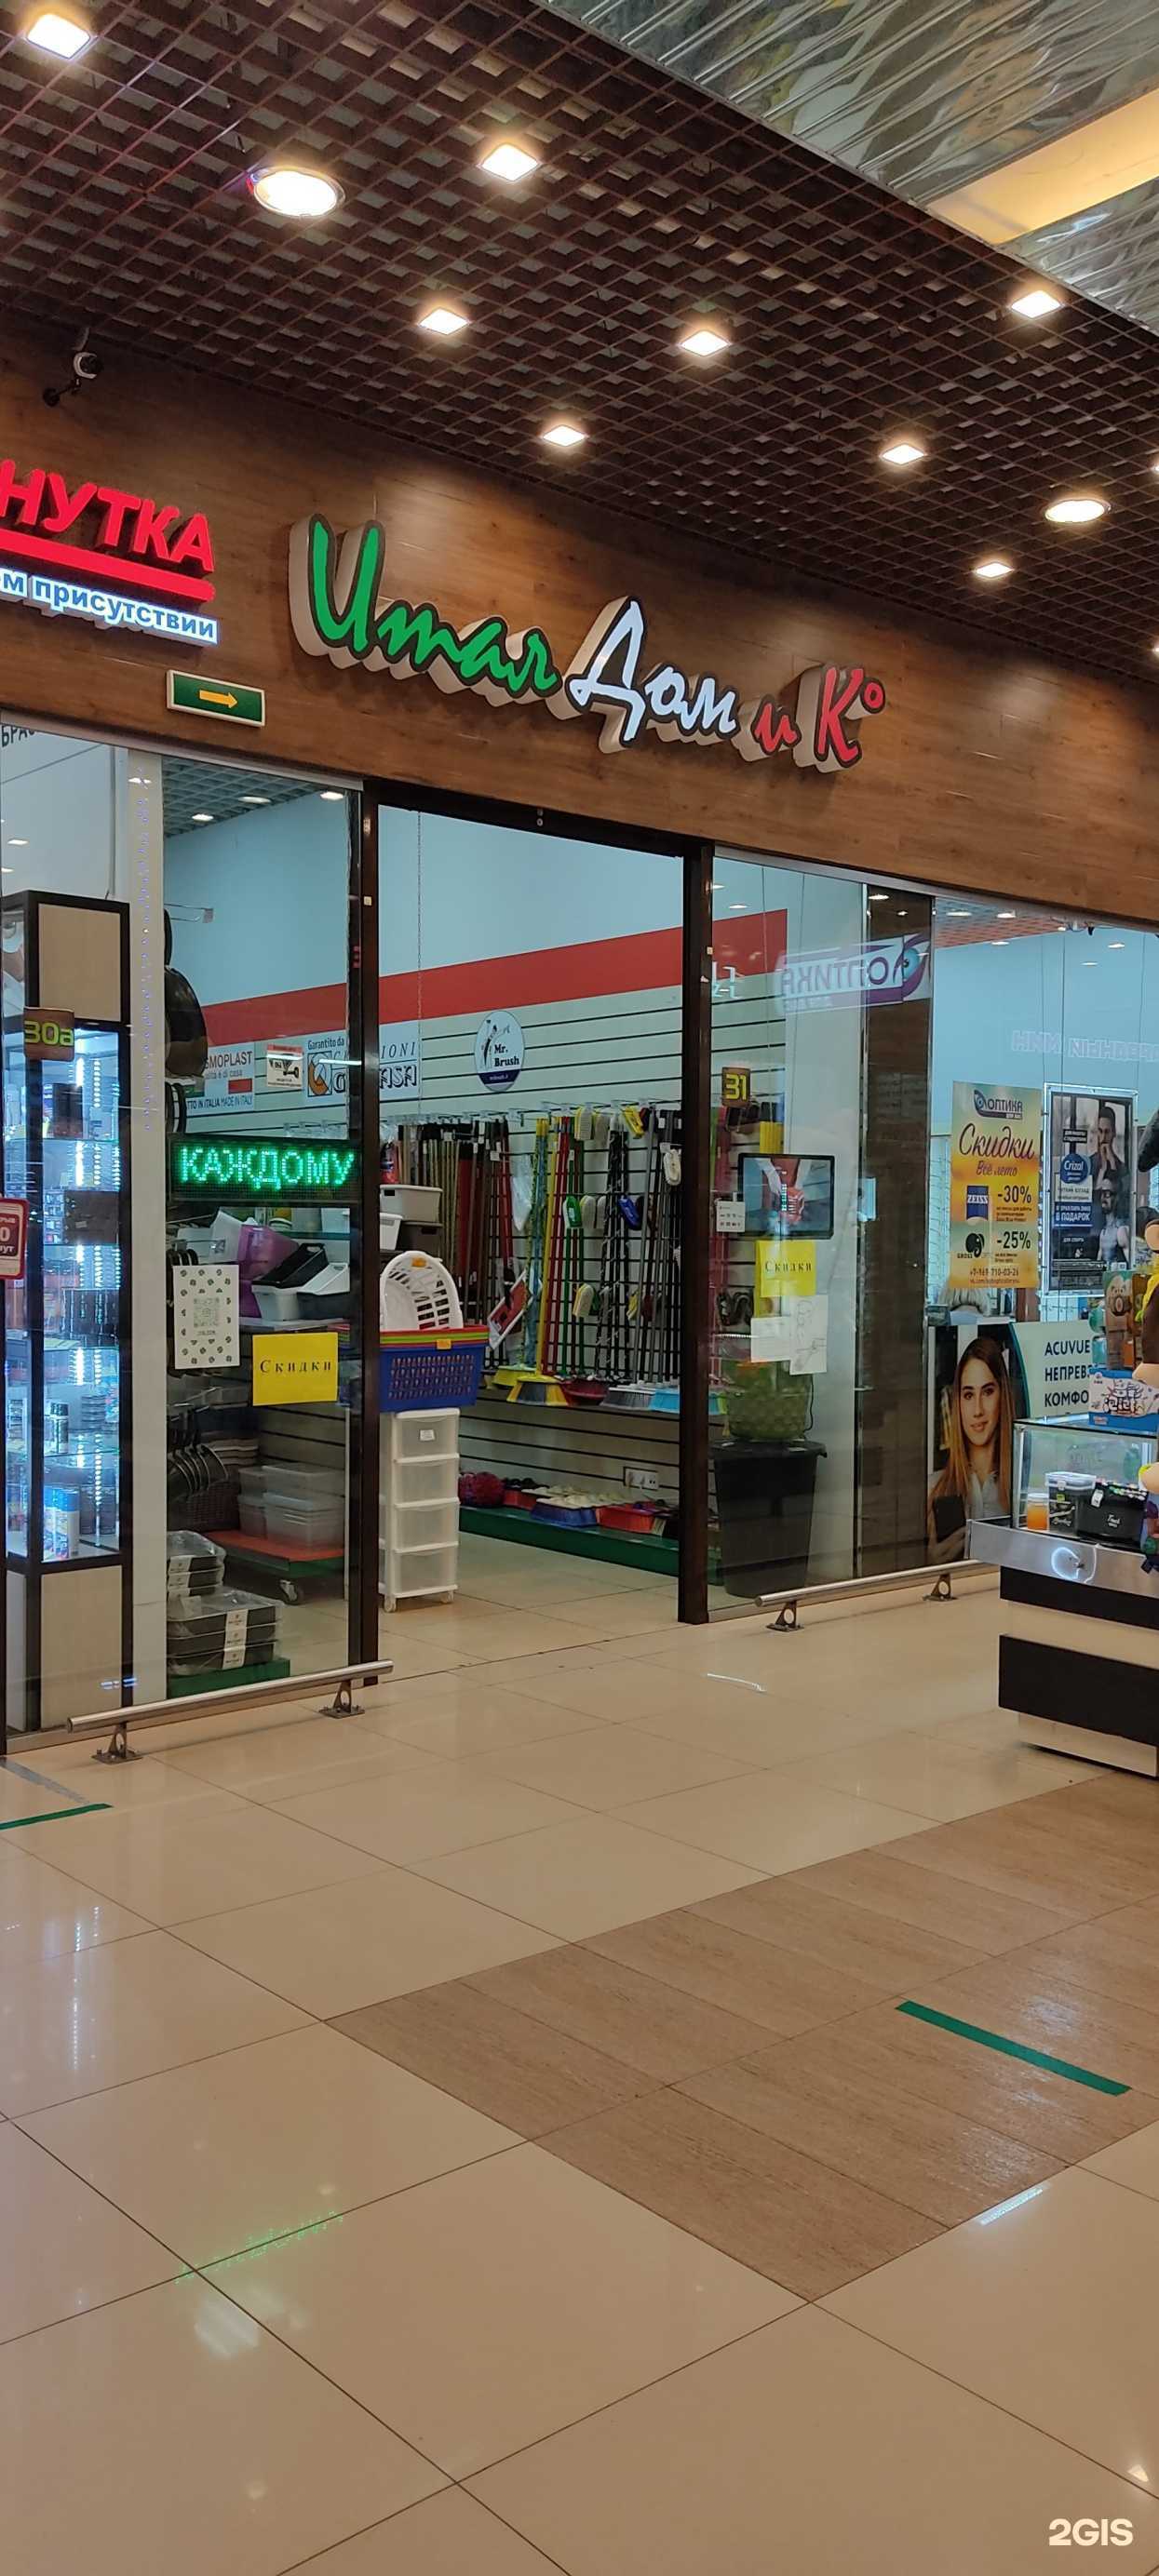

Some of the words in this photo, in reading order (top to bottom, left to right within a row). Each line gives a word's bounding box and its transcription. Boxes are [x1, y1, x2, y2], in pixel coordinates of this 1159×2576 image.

[34, 578, 215, 638] присутствии
[494, 1043, 508, 1054] Mr.
[494, 1055, 519, 1067] Brush
[725, 1074, 747, 1100] 31
[987, 1098, 1023, 1112] ОПТИКА
[959, 1122, 1035, 1161] Скидки
[180, 1145, 356, 1190] КАЖДОМУ
[967, 1194, 989, 1204] ZEISS
[997, 1185, 1032, 1204] -30%
[1061, 1212, 1090, 1222] ПОДАРОК
[996, 1230, 1031, 1250] -25%
[765, 1259, 812, 1273] Скидки
[1044, 1339, 1091, 1356] ACUVUE
[260, 1359, 331, 1374] Скидки
[1044, 1389, 1089, 1408] КОМФО
